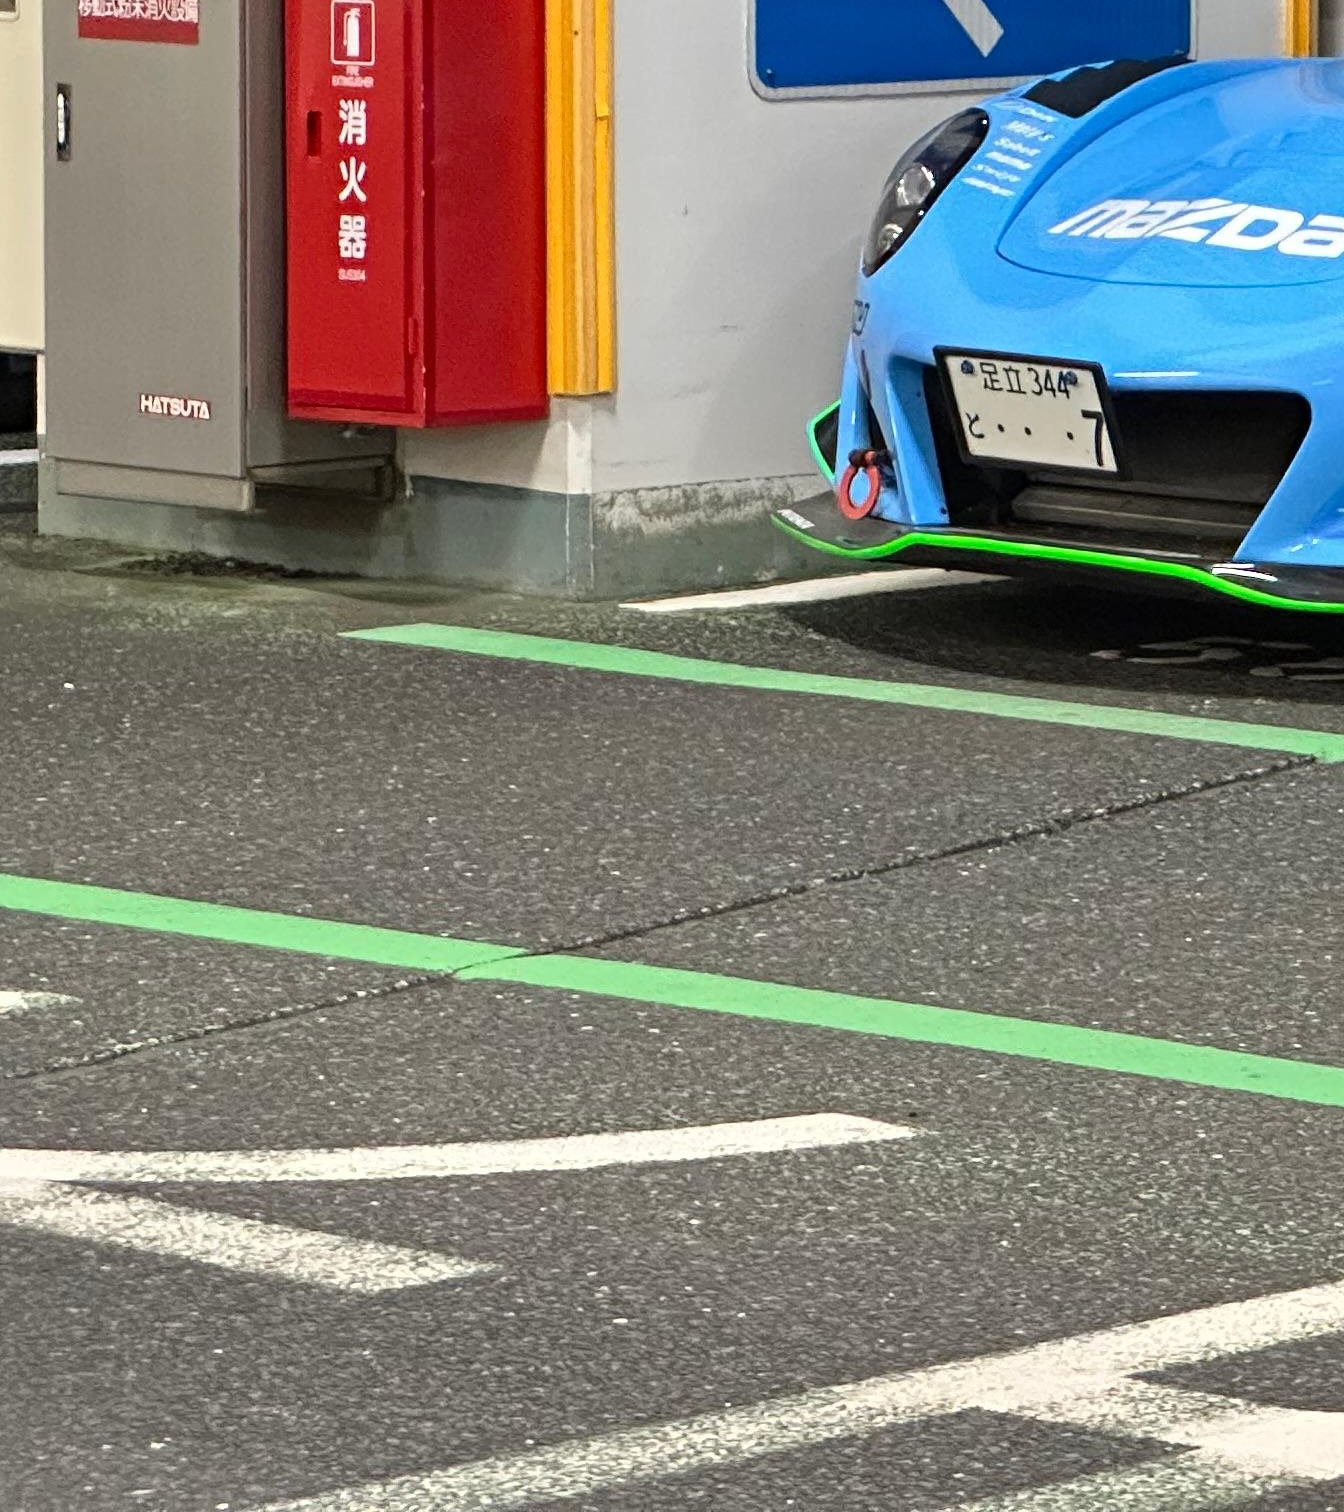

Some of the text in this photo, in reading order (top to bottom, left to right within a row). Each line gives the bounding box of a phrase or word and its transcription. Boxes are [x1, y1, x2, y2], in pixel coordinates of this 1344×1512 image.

[338, 98, 367, 259] 消火器
[140, 393, 210, 420] HATSUTA
